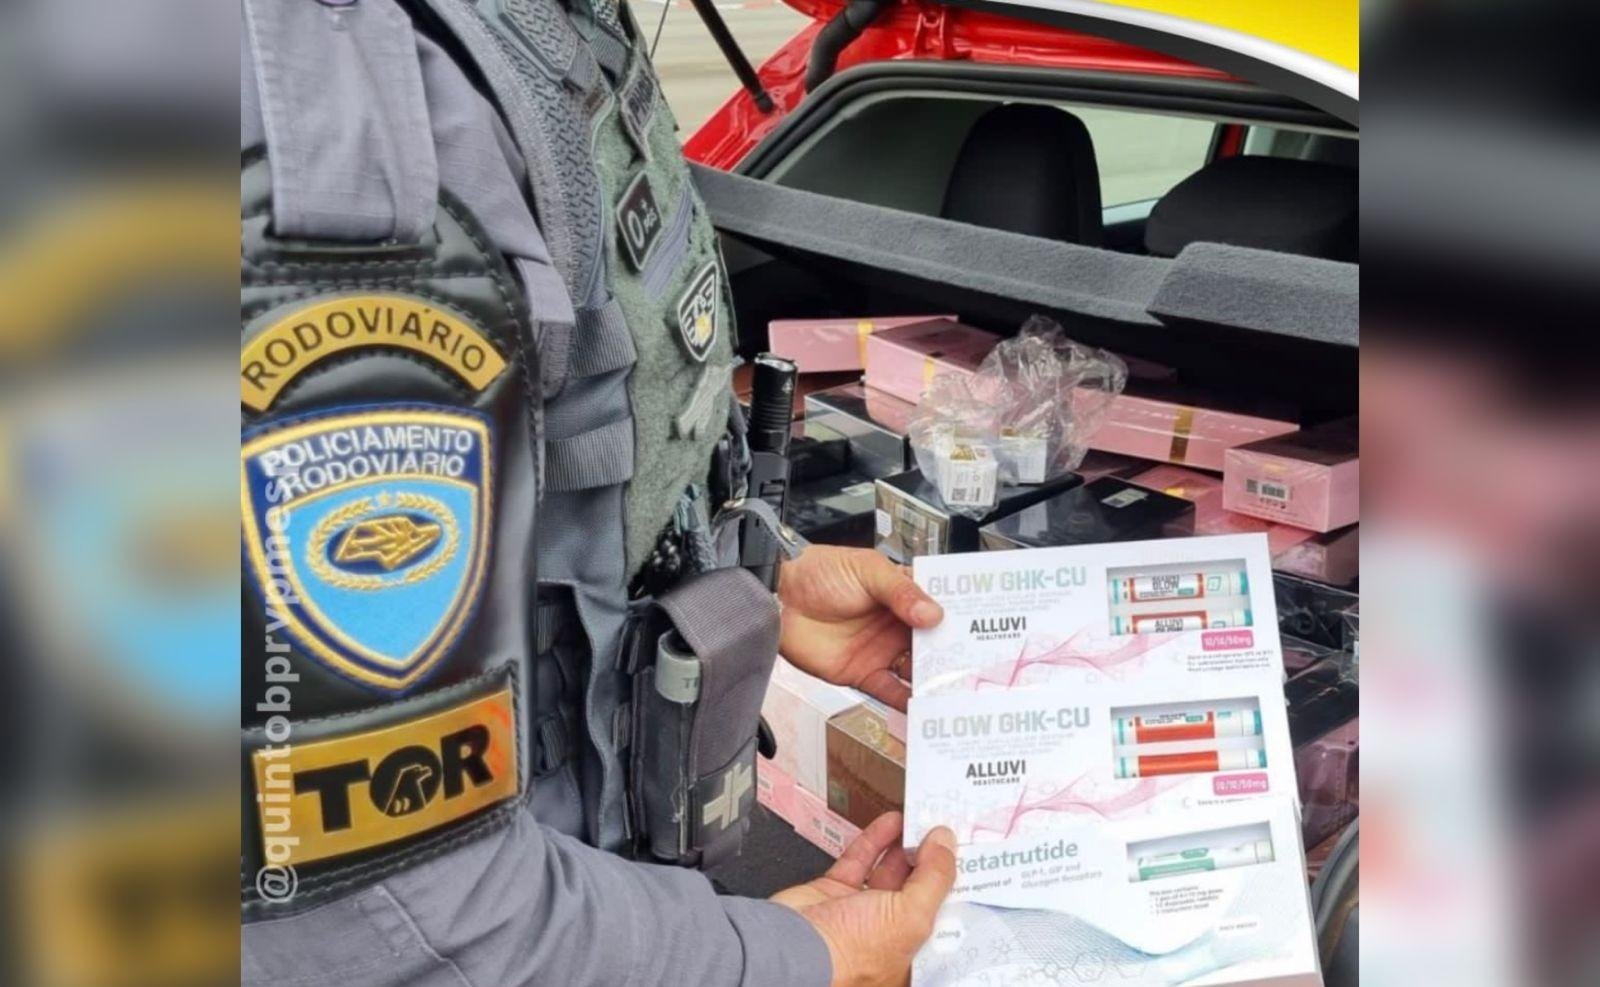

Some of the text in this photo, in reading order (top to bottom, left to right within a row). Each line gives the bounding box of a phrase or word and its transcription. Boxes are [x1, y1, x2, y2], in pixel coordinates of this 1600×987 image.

[241, 306, 486, 391] RODOVIÁRIO
[258, 425, 473, 476] POLICIAMENTO
[928, 566, 1087, 596] GLOW GHK-CU
[970, 616, 1027, 634] ALLUVI
[976, 632, 1021, 642] HEALTHCARE
[922, 706, 1090, 740] GLOW GHK-CU
[293, 724, 494, 833] TOR
[966, 759, 1026, 779] ALLUVI
